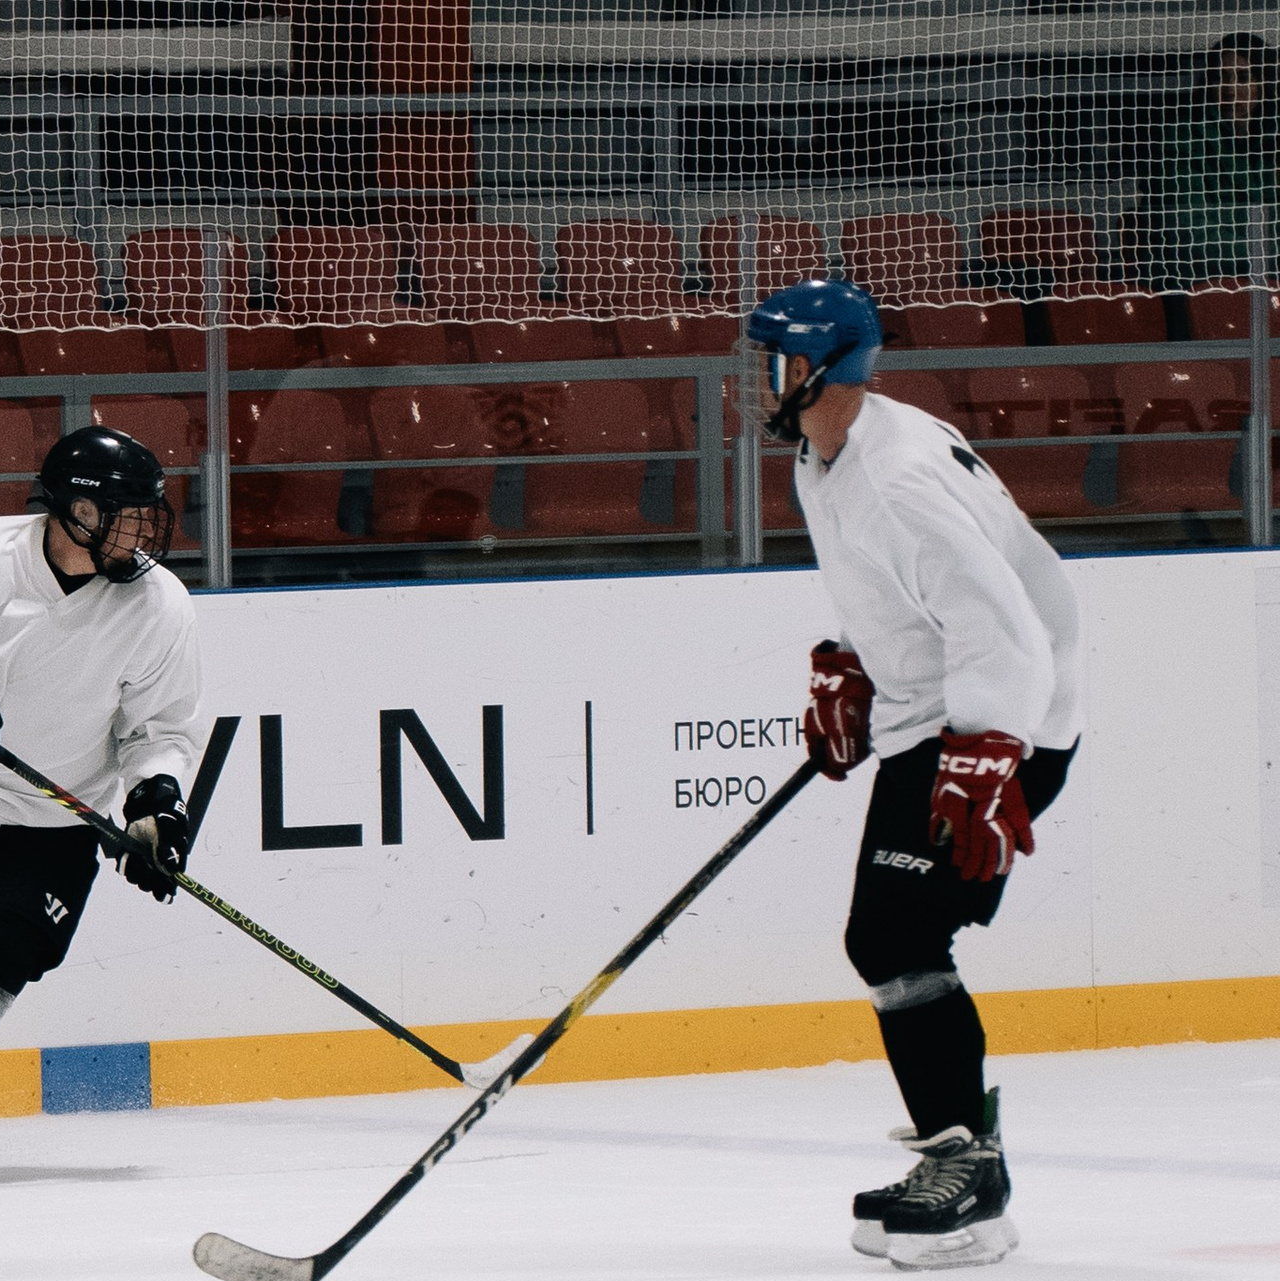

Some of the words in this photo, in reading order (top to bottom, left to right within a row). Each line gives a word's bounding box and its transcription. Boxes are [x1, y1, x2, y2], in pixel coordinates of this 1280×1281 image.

[71, 477, 101, 487] CCM
[675, 775, 766, 808] БЮРО
[174, 872, 339, 989] SHERWOOD
